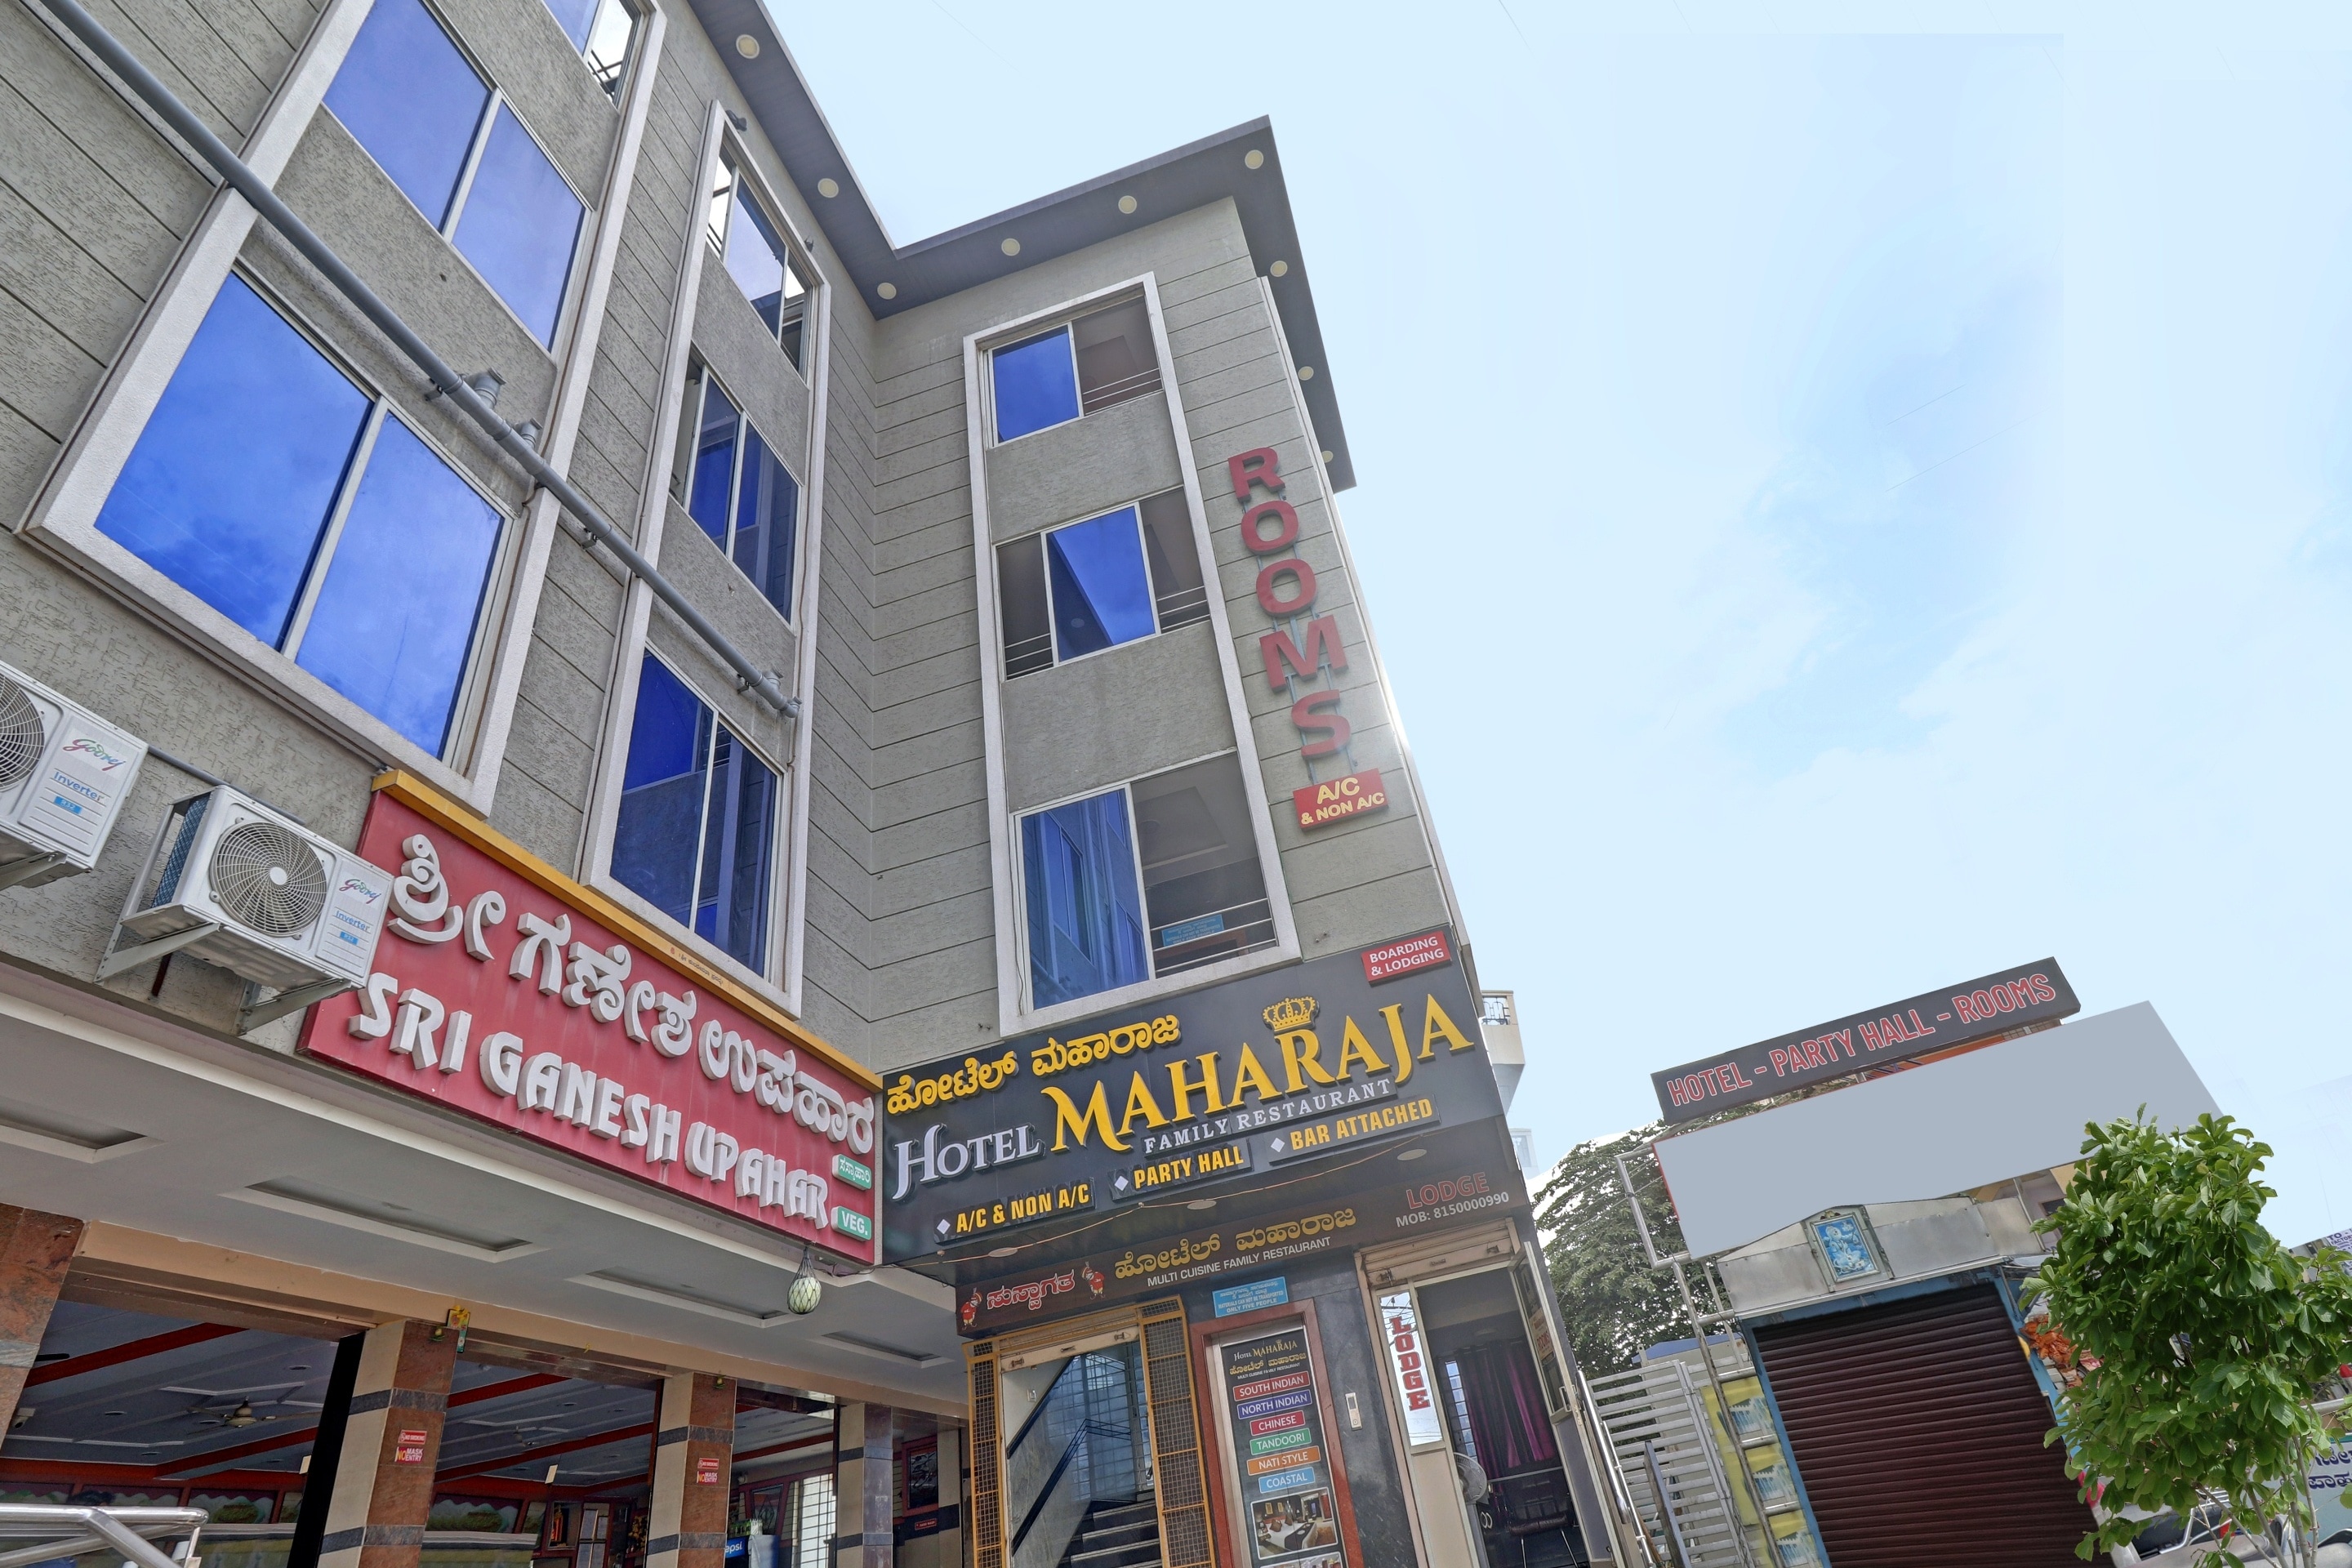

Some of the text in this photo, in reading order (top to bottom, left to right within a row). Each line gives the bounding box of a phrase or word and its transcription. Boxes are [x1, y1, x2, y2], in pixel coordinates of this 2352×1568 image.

[1227, 447, 1351, 760] ROOMS
[63, 739, 127, 771] Godrej
[54, 772, 105, 801] Inverter
[1316, 777, 1360, 804] A/C
[1301, 792, 1385, 825] & NON A/C
[339, 879, 381, 904] Godrej
[336, 911, 371, 931] Inverter
[1370, 936, 1438, 963] BOARDING
[1371, 948, 1444, 976] & LODGING
[387, 834, 875, 1155] ಶ್ರೀ ಗಣೇಶ ಉಪಹಾರ
[1666, 1062, 1752, 1107] HOTEL
[1768, 1028, 1856, 1077] PARTY
[1859, 1009, 1936, 1052] HALL
[1952, 973, 2056, 1024] ROOMS
[886, 1014, 1182, 1115] ಹೋಟೆಲ್ ಮಹಾರಾಜ
[349, 972, 829, 1229] SRI GANESH UPAHAR
[892, 993, 1475, 1200] HOTEL MAHARAJA
[1144, 1078, 1391, 1154] FAMILY RESTAURANT
[1290, 1098, 1433, 1151] BAR ATTACHED
[1134, 1145, 1244, 1189] PARTY HALL
[1405, 1171, 1490, 1209] LODGE
[956, 1183, 1090, 1233] A/C & NON A/C
[1396, 1192, 1509, 1227] MOB: 8150000990
[841, 1210, 868, 1236] VEG.
[1114, 1208, 1356, 1279] ಹೋಟೆಲ್ ಮಹಾರಾಜ
[1147, 1236, 1331, 1287] MULTI CUISINE FAMILY RESTAURANT
[987, 1269, 1076, 1311] ಸುಸ್ವಾಗತ
[1218, 1300, 1237, 1308] MATERIALS
[1227, 1305, 1241, 1313] ONLY
[1256, 1298, 1277, 1307] PEOPLE
[1252, 1340, 1298, 1356] MAHARAJA
[1229, 1360, 1264, 1375] ಹೋಟೆಲ್
[1389, 1316, 1431, 1411] LODGE
[1240, 1375, 1304, 1396] SOUTH INDIAN
[1241, 1393, 1307, 1416] NORTH INDIAN
[1258, 1417, 1297, 1431] CHINESE
[398, 1450, 407, 1460] NO
[1257, 1432, 1305, 1450] TANDOORI
[1258, 1452, 1308, 1469] NATI STYLE
[1267, 1472, 1307, 1488] COASTAL
[724, 1541, 743, 1554] epsi
